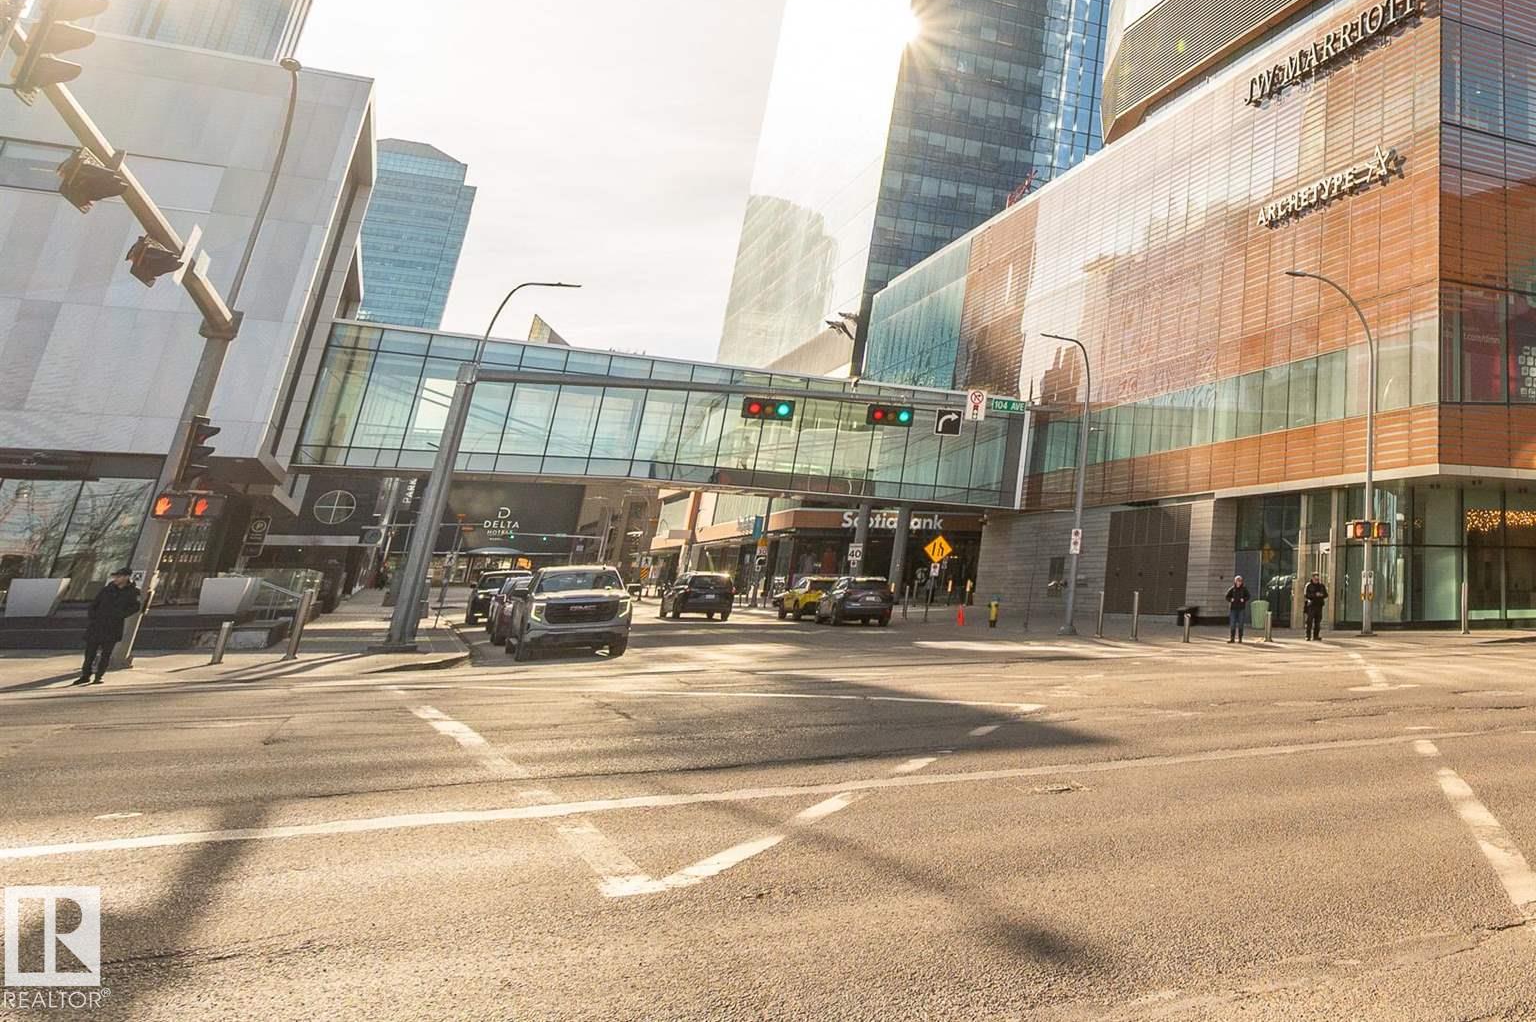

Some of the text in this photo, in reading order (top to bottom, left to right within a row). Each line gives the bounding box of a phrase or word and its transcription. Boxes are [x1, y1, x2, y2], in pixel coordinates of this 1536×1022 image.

[1255, 169, 1358, 227] ARCHETYPE
[994, 400, 1025, 412] 104 AVE
[483, 520, 520, 529] DELTA
[841, 511, 943, 530] Sctiaank
[848, 549, 861, 558] 40
